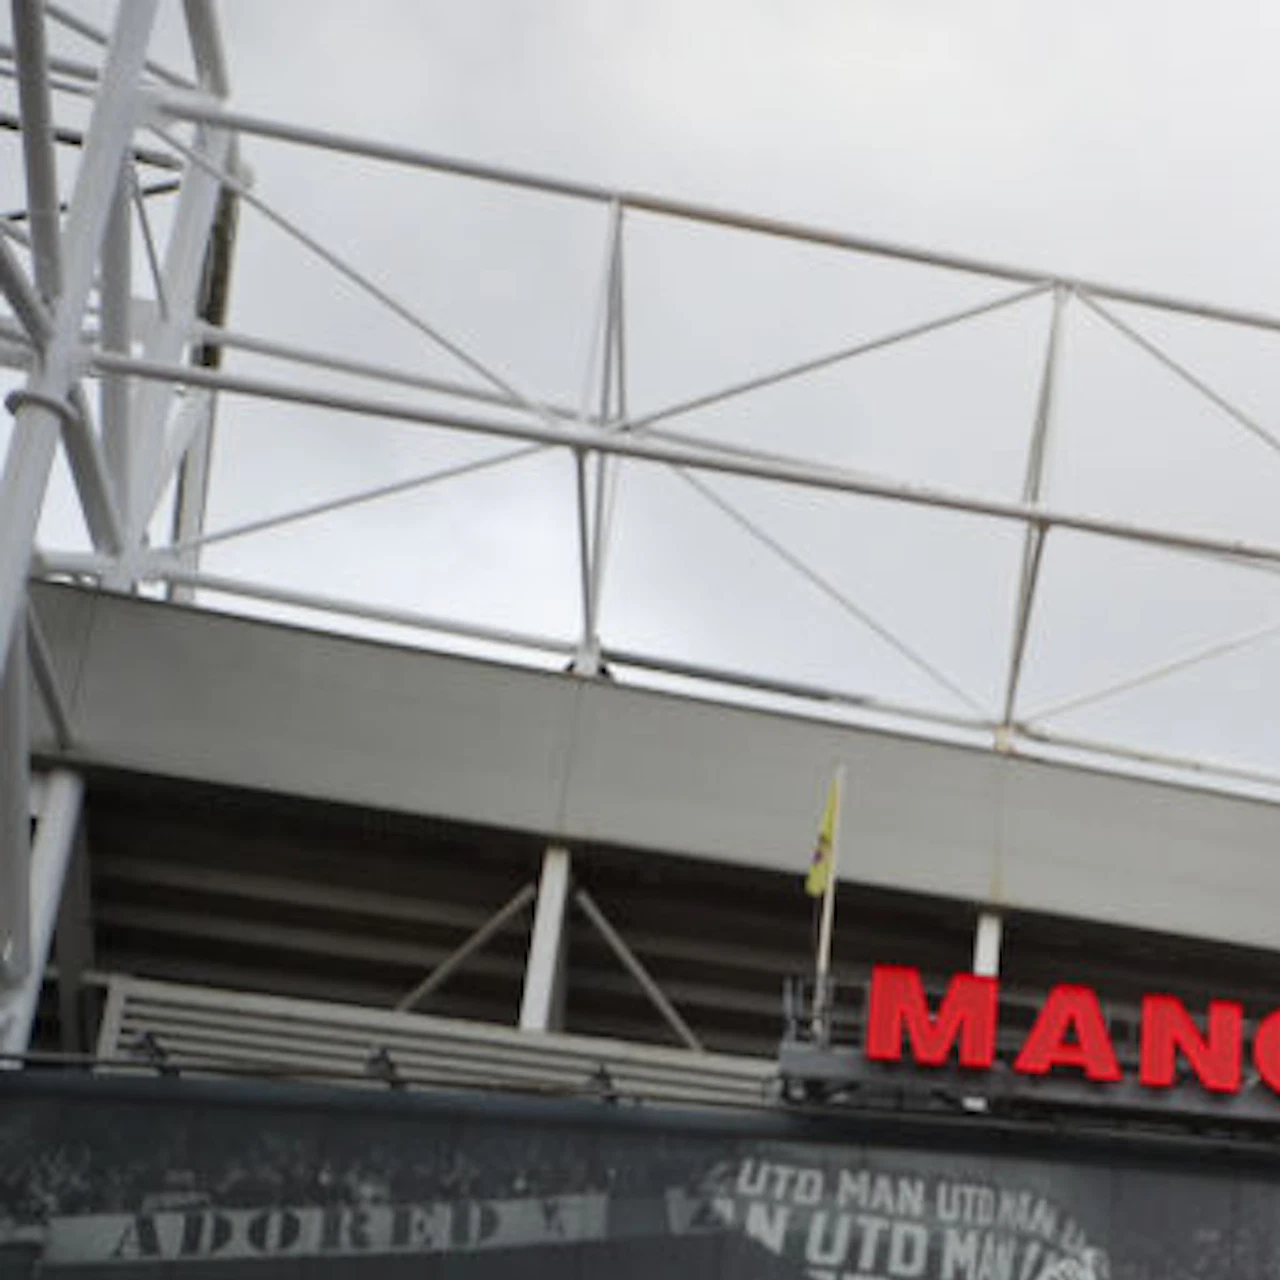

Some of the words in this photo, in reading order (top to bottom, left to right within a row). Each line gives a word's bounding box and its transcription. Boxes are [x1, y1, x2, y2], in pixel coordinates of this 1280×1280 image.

[735, 1158, 823, 1208] UTD
[834, 1166, 924, 1221] MAN
[936, 1180, 995, 1229] UTD
[803, 1206, 929, 1280] UTD
